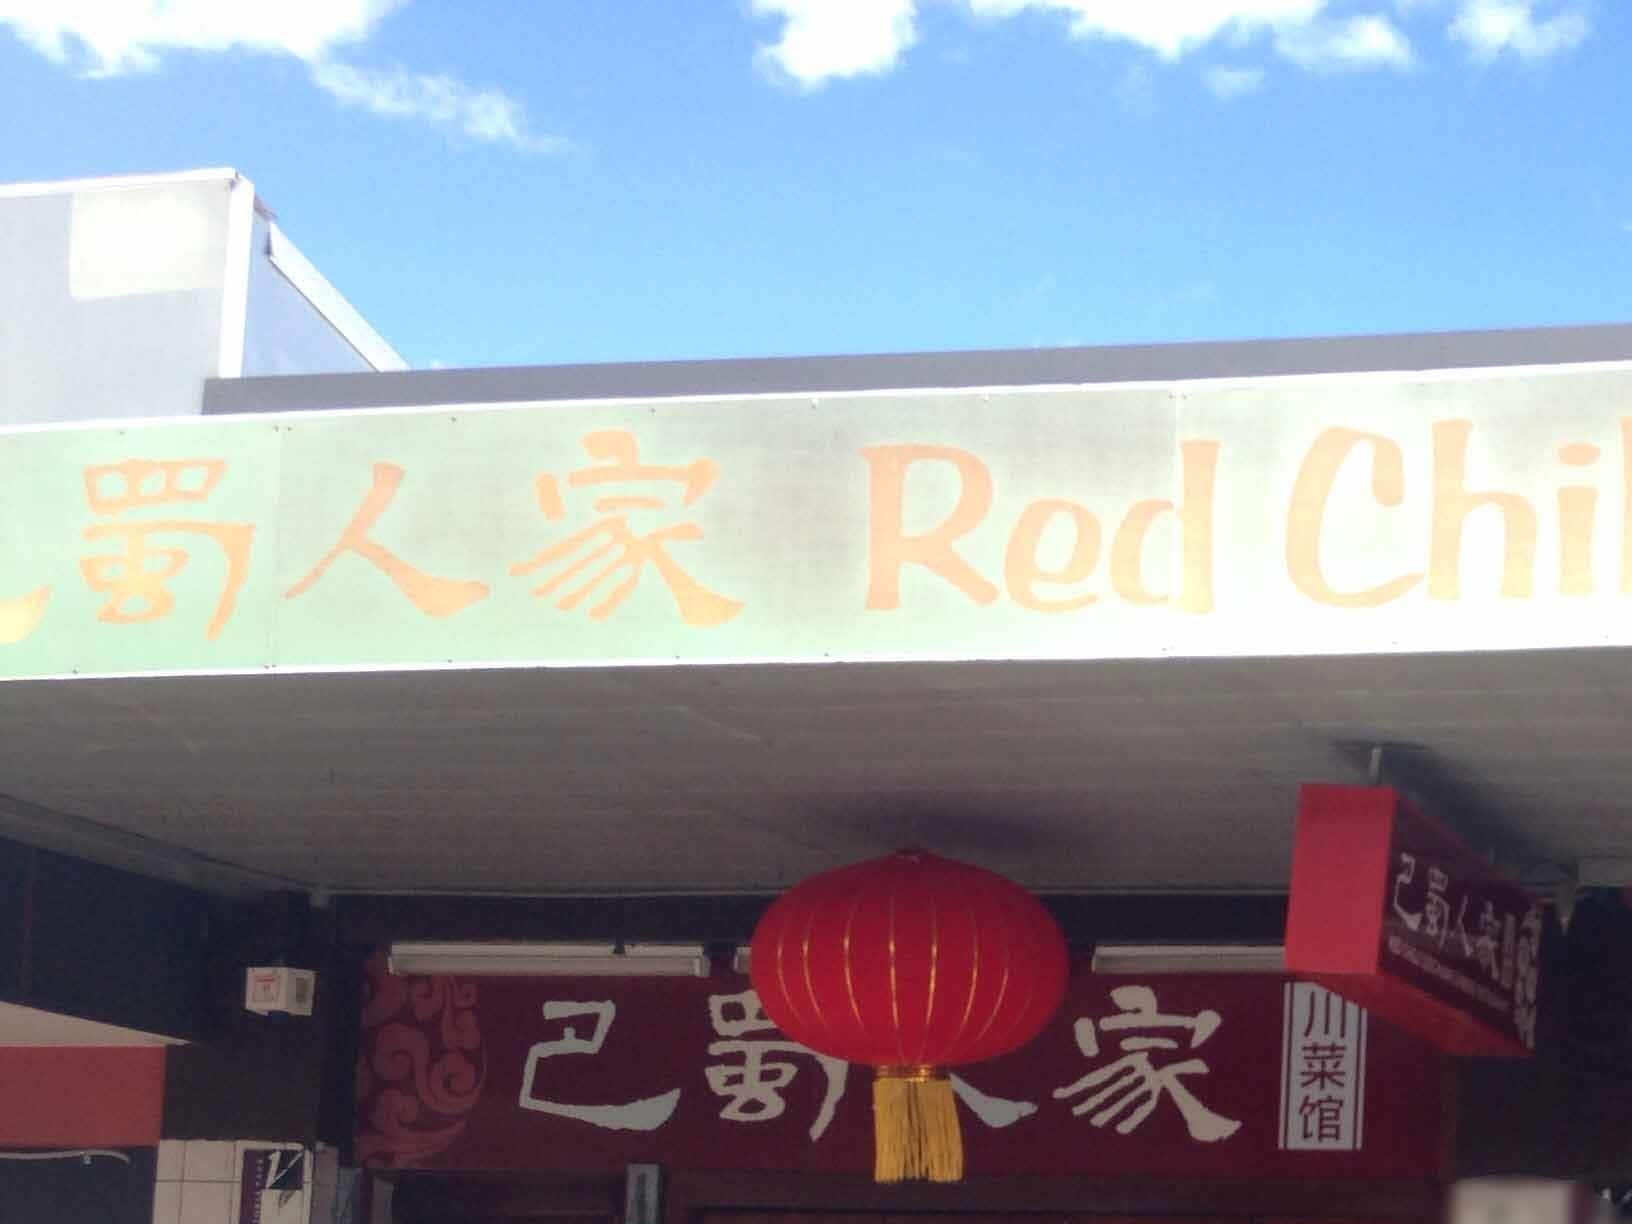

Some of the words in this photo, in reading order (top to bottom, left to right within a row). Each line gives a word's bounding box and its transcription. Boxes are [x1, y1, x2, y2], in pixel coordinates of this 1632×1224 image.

[0, 429, 746, 645] 蜀人家
[856, 438, 1221, 615] Red
[1298, 991, 1347, 1144] 川菜馆
